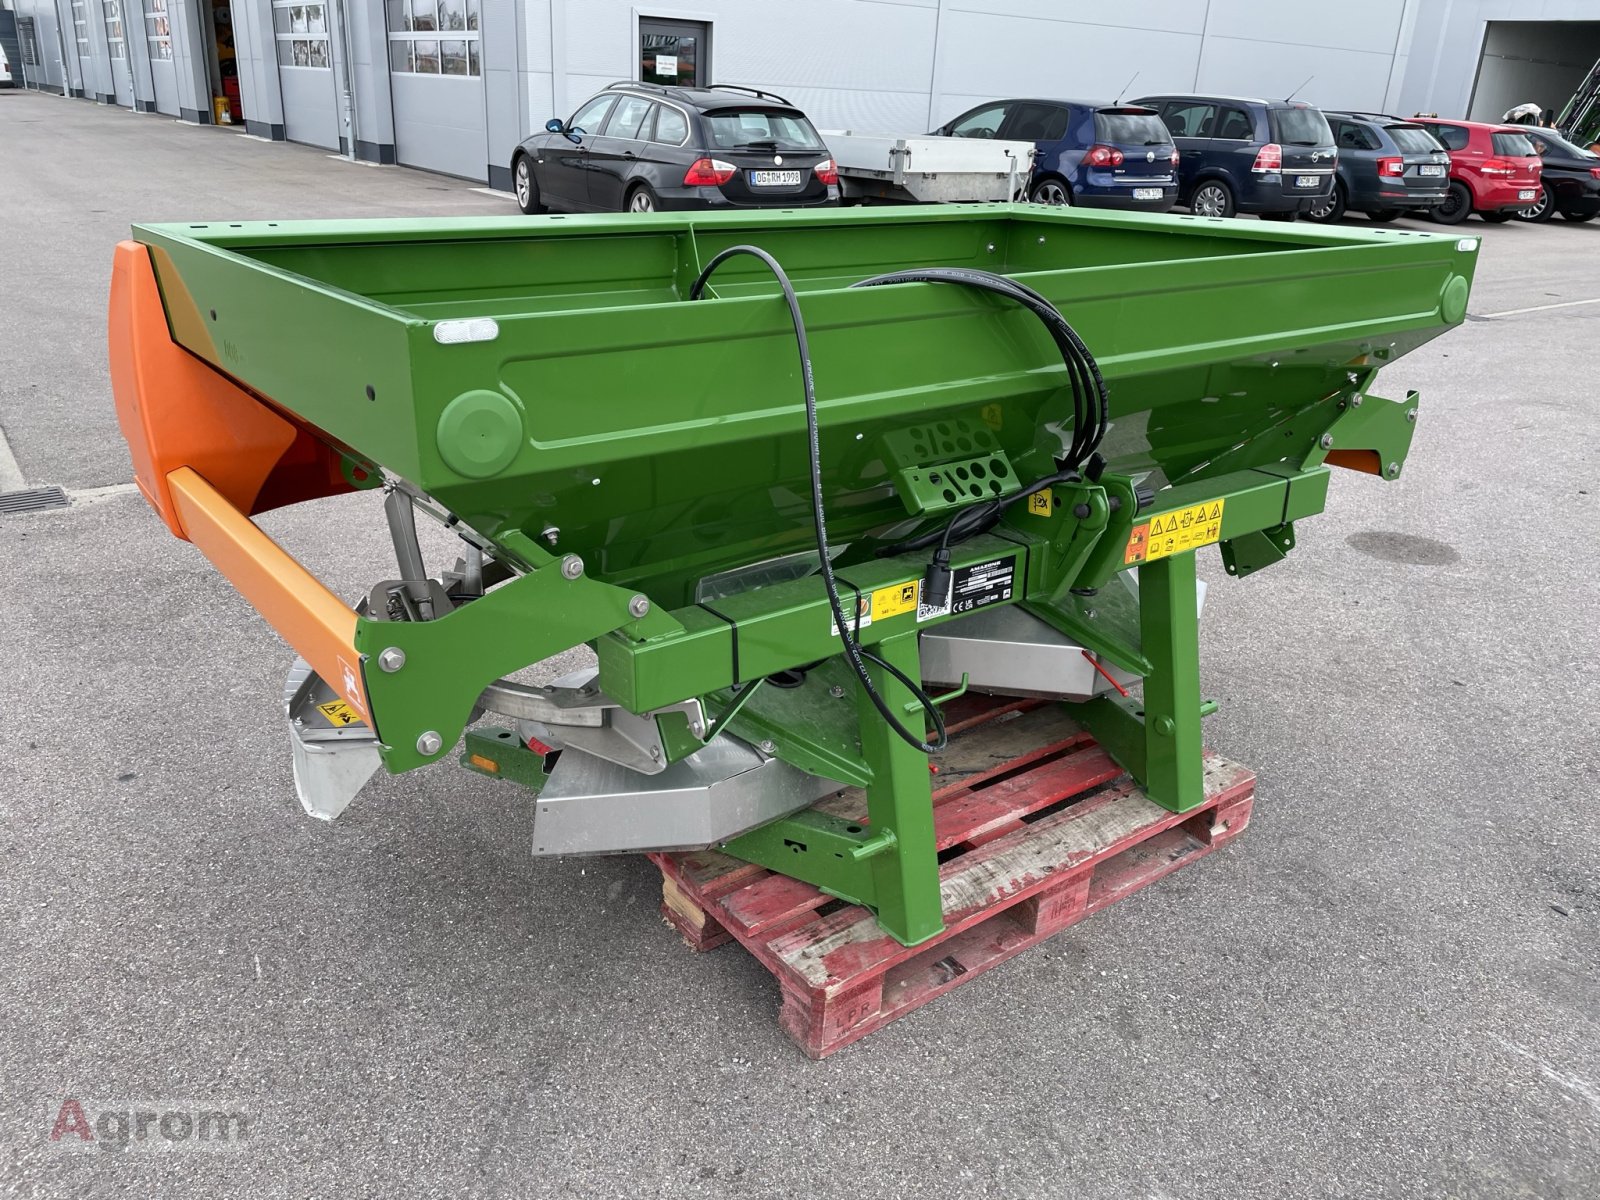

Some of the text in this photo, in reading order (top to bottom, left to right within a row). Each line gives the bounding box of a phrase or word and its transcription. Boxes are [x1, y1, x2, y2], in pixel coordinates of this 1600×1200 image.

[757, 171, 799, 182] OG RH 1998
[970, 560, 1001, 573] AMAZONE
[836, 1001, 870, 1028] LPR
